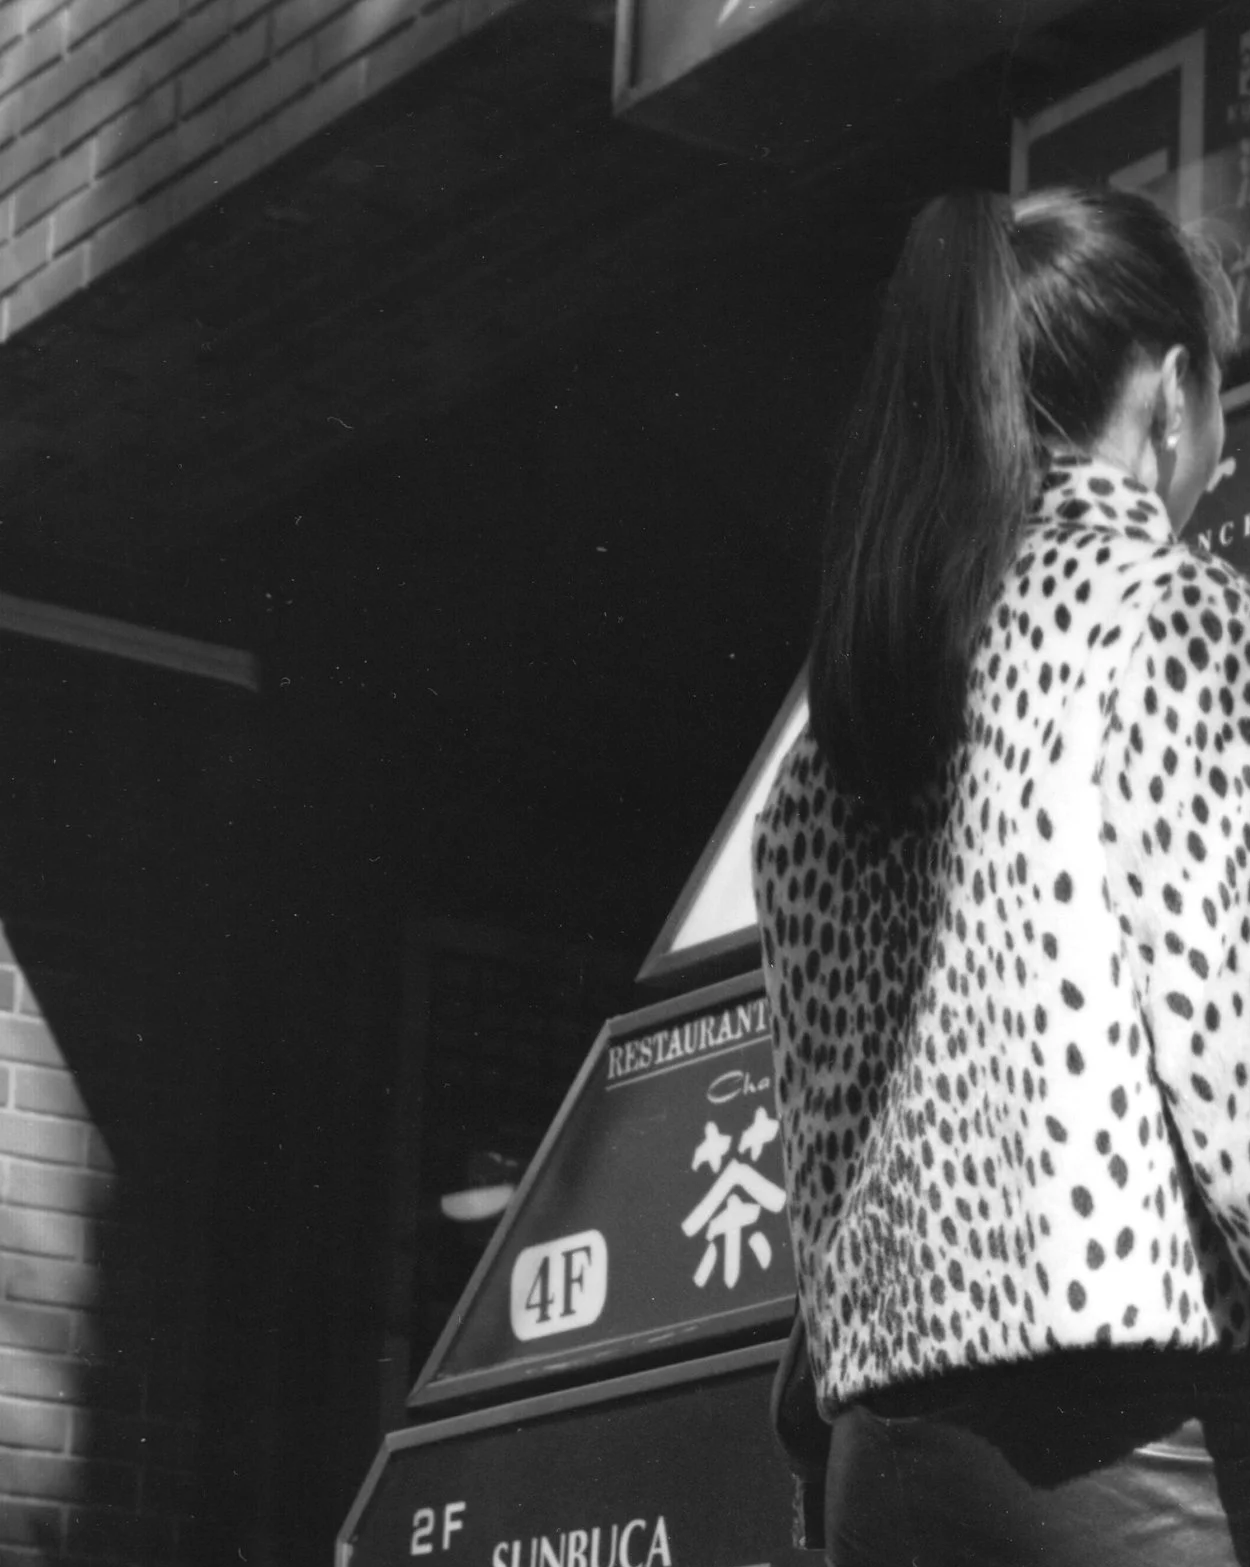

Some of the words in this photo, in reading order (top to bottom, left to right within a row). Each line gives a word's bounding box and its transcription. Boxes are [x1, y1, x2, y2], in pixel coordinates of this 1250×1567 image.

[606, 997, 771, 1081] RESTAURANT
[705, 1069, 771, 1105] Cha
[681, 1106, 787, 1289] 茶
[523, 1245, 593, 1324] 4F
[410, 1500, 467, 1556] 2F
